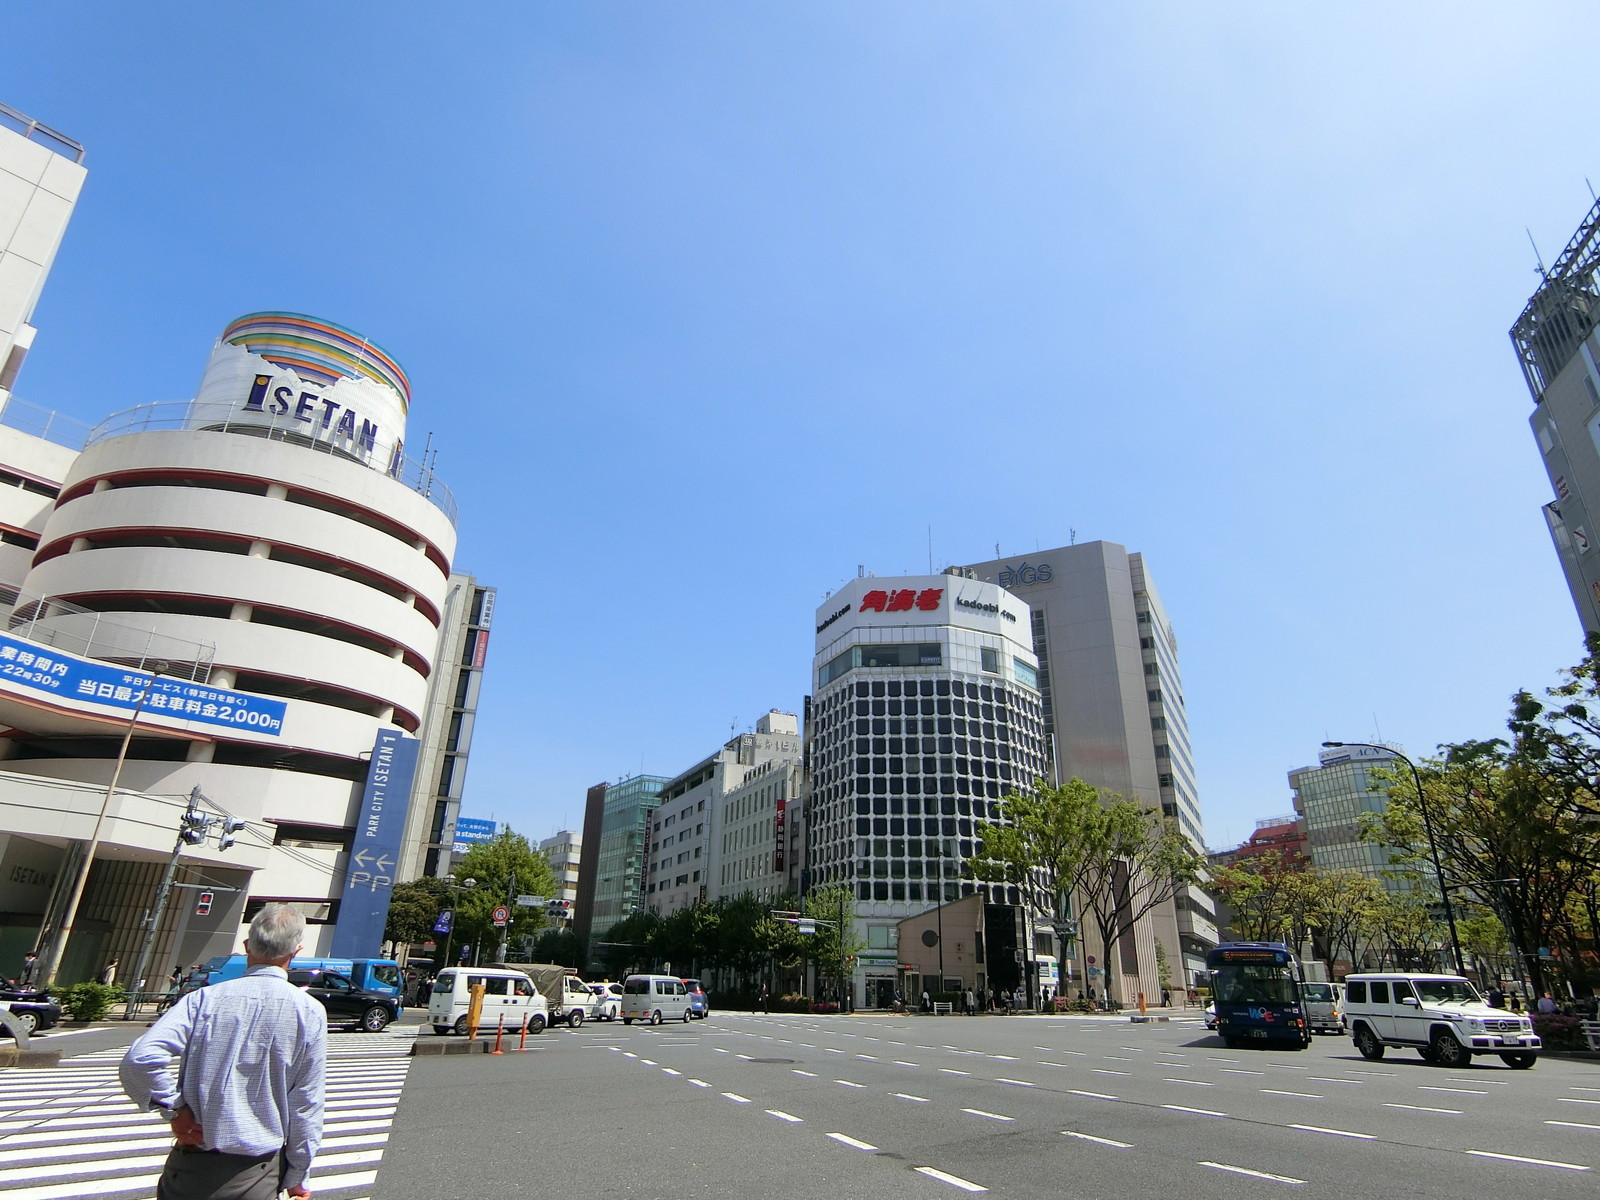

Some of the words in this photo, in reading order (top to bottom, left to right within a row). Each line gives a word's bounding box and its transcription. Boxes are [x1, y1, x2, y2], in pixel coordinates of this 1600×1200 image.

[242, 374, 378, 452] ISETAN
[998, 562, 1053, 588] BYGS
[0, 645, 69, 677] 業時間内
[77, 679, 281, 729] 当日最大駐車料金2,000円
[373, 746, 394, 787] ISETAN
[1356, 747, 1380, 757] ACN
[371, 791, 384, 812] CITY
[366, 814, 381, 837] PARK
